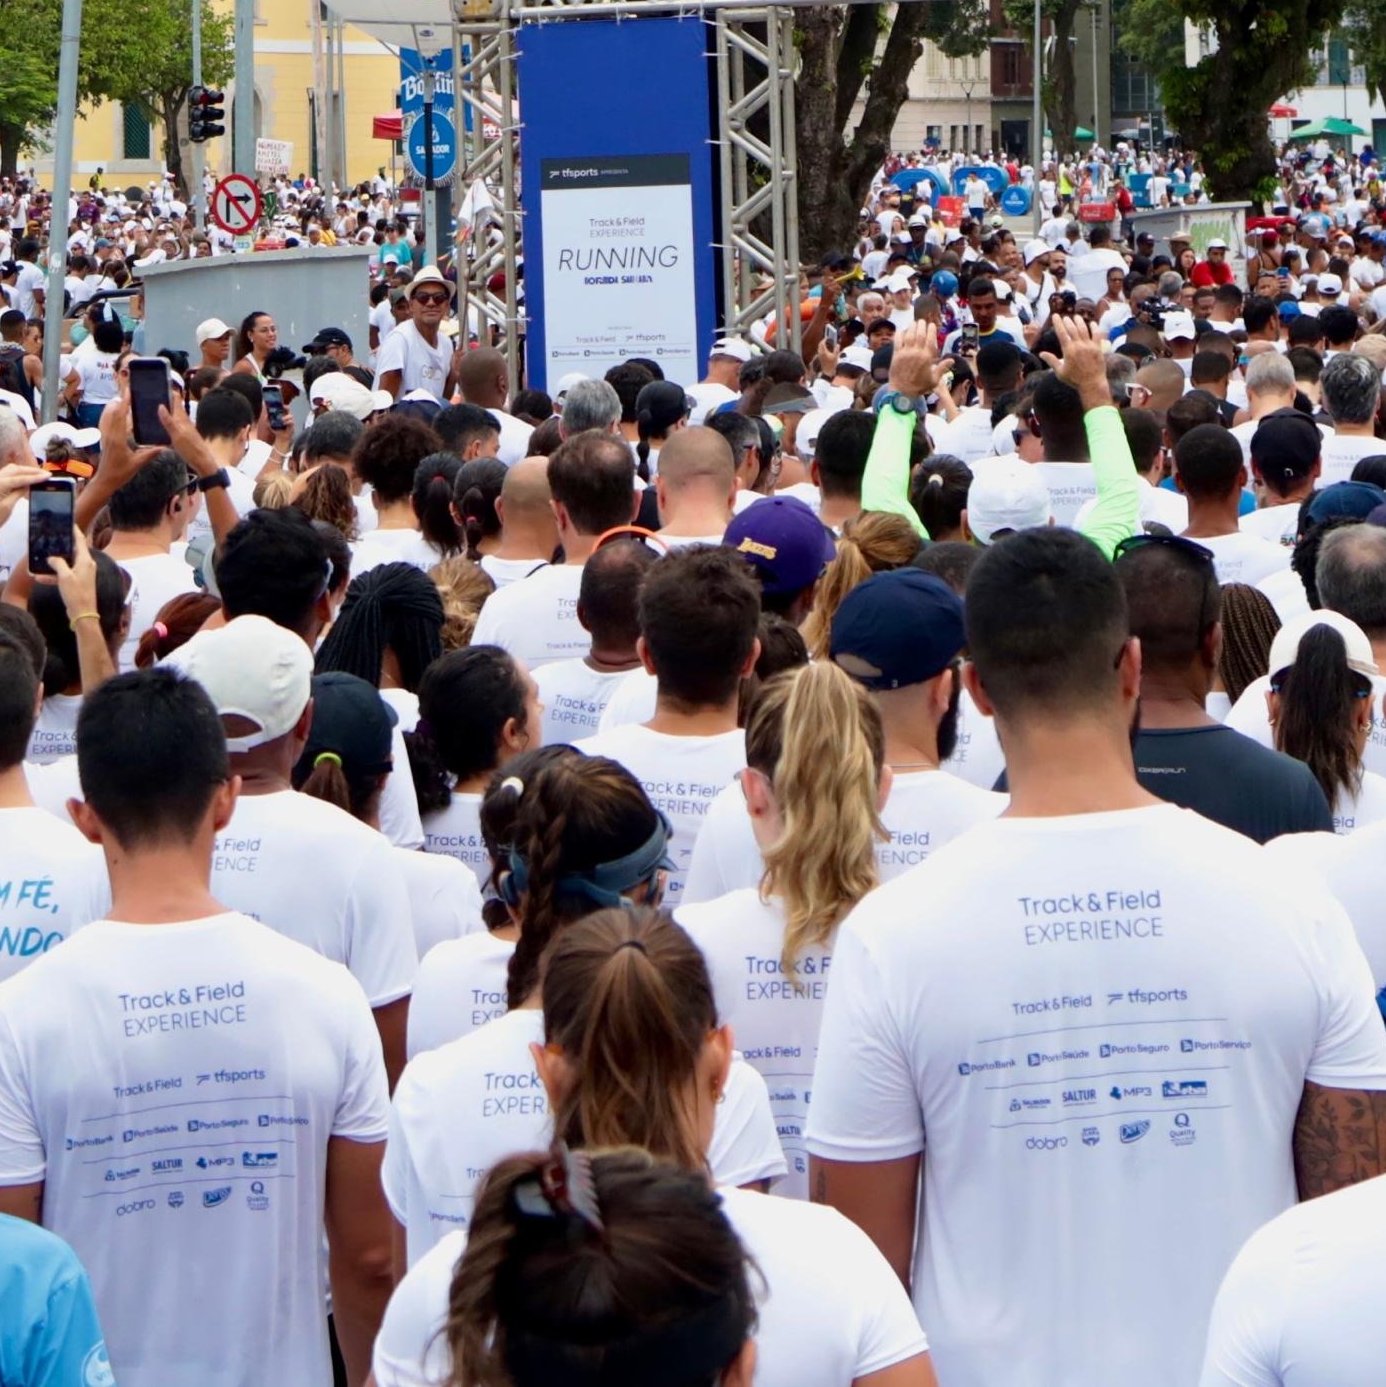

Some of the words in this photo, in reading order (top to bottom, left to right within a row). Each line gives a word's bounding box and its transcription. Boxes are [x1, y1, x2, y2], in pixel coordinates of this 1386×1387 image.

[562, 168, 598, 178] tfsports
[589, 228, 645, 238] EXPERIENCE
[559, 245, 678, 271] RUNNING
[551, 709, 598, 727] EXPERIE
[641, 781, 675, 794] rack
[223, 837, 261, 852] Field
[1018, 895, 1083, 917] Track
[1106, 890, 1162, 912] Field
[1024, 917, 1163, 946] EXPERIENCE
[118, 991, 176, 1012] Track
[195, 981, 245, 1002] Field
[747, 981, 827, 1000] EXPERIE
[1128, 988, 1188, 1005] tfsports
[1013, 1000, 1050, 1016] Track
[1062, 995, 1092, 1010] Field
[123, 1005, 246, 1037] EXPERIENCE
[743, 1047, 763, 1060] ack
[774, 1046, 801, 1057] Field
[214, 1069, 266, 1084] tfsports
[113, 1085, 145, 1099] Track
[154, 1078, 182, 1092] Field
[1062, 1089, 1097, 1102] SALTUR
[1123, 1087, 1152, 1097] MP3
[483, 1097, 549, 1117] EXPER
